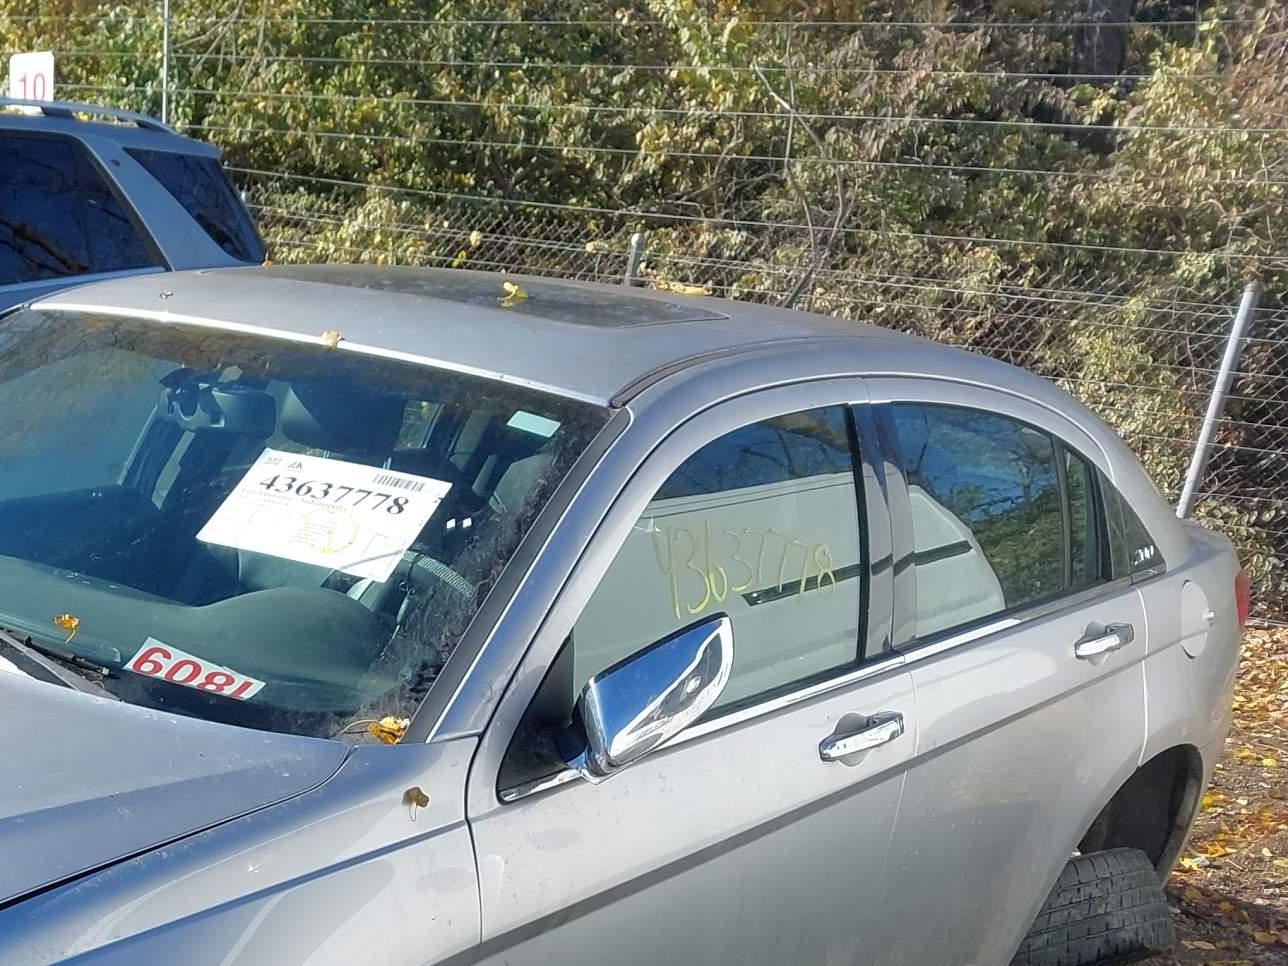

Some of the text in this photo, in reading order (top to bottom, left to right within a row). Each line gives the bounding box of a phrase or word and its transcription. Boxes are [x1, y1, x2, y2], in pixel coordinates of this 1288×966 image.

[19, 72, 46, 102] 10
[259, 474, 410, 515] 43637778
[651, 520, 837, 620] 43637778
[132, 646, 253, 699] 6081
